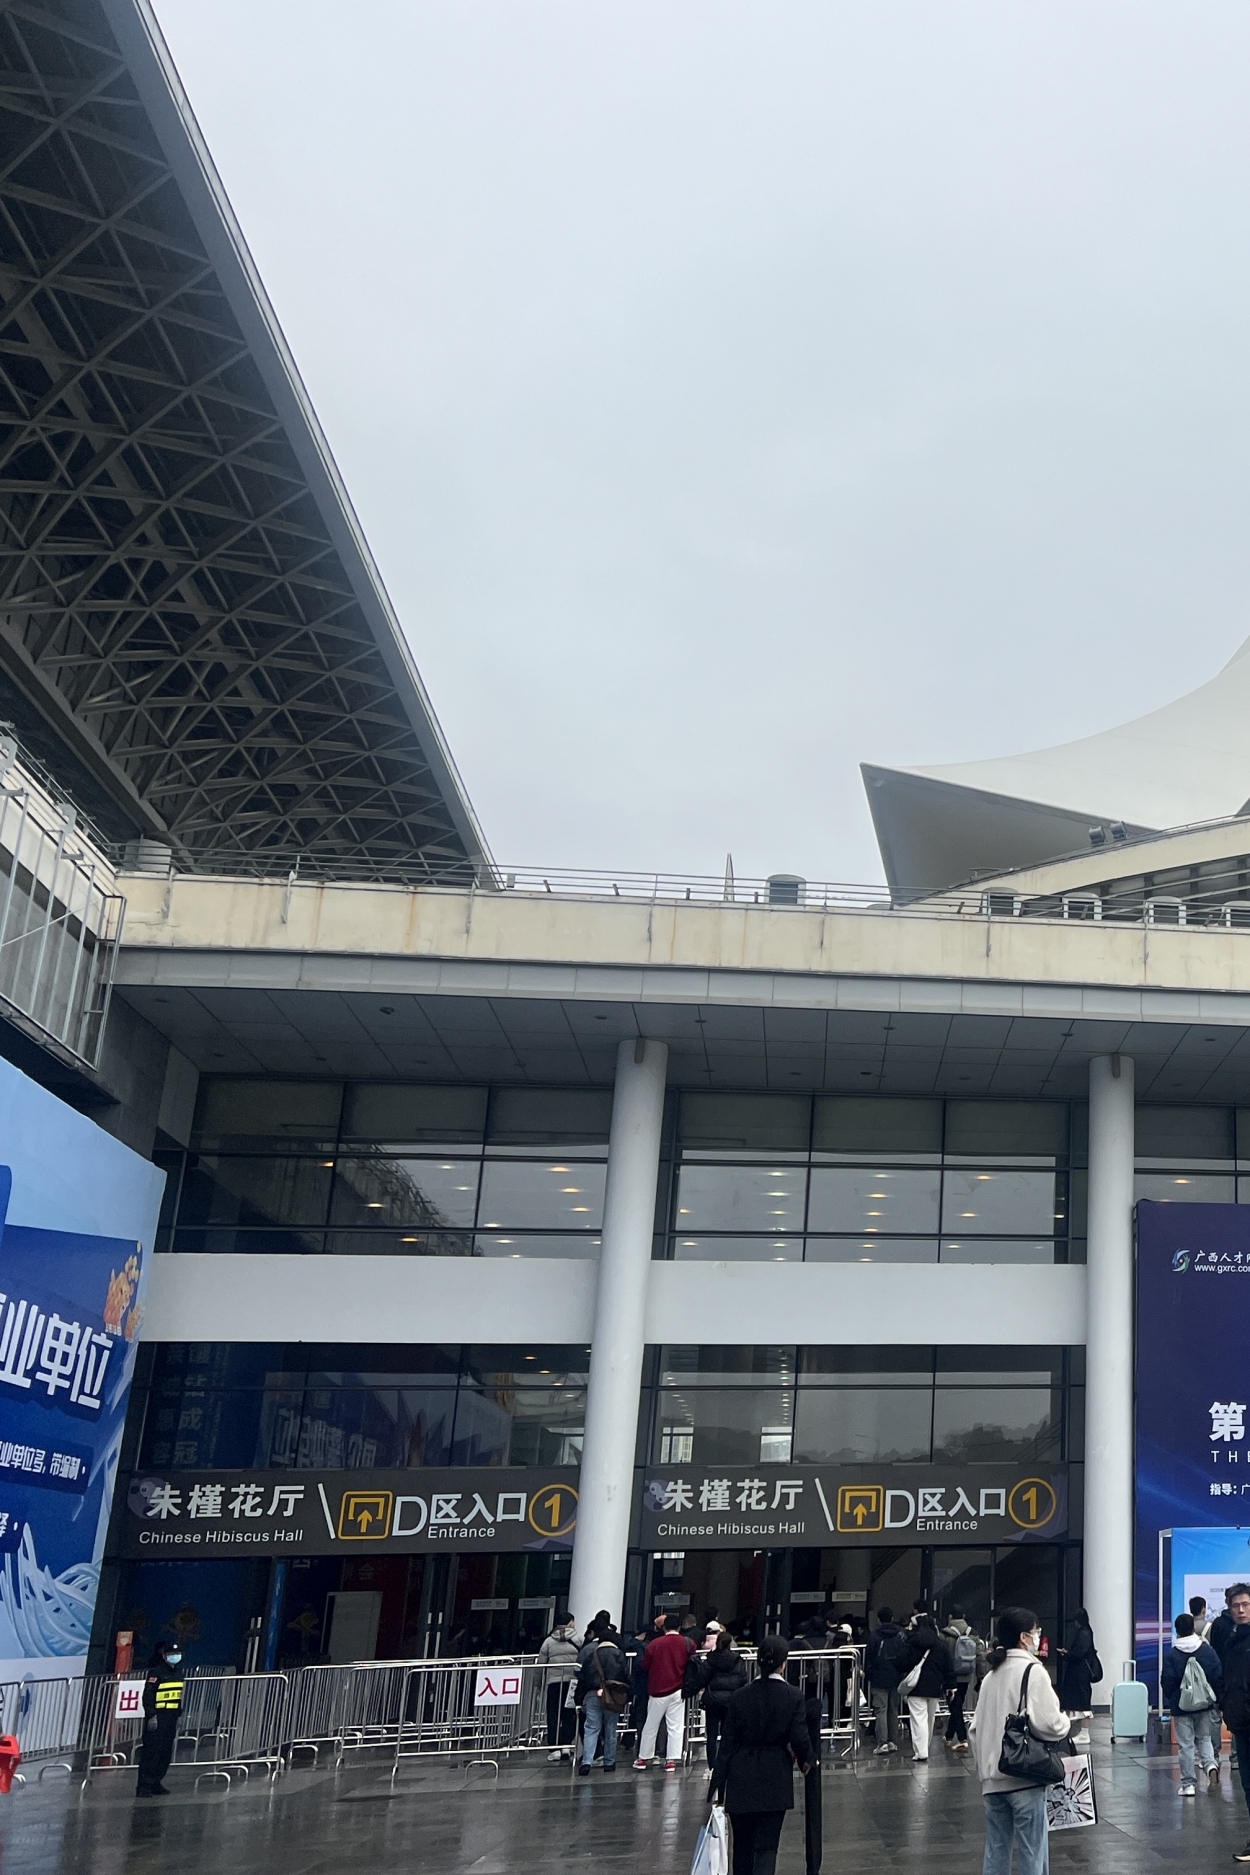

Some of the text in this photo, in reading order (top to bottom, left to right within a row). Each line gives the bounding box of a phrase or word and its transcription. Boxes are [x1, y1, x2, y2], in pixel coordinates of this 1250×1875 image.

[0, 1293, 113, 1409] 业单位
[146, 1484, 305, 1520] 朱槿花厅
[664, 1478, 804, 1513] 朱槿花厅
[392, 1492, 527, 1536] D区入口
[885, 1487, 1006, 1528] D区入口
[139, 1529, 304, 1544] Chinese Hibiscus Hall
[428, 1525, 496, 1539] Entrance
[657, 1522, 805, 1536] Chinese Hibiscus Hall
[916, 1519, 978, 1532] Entrance
[478, 1676, 520, 1698] 入口
[119, 1690, 139, 1711] 出
